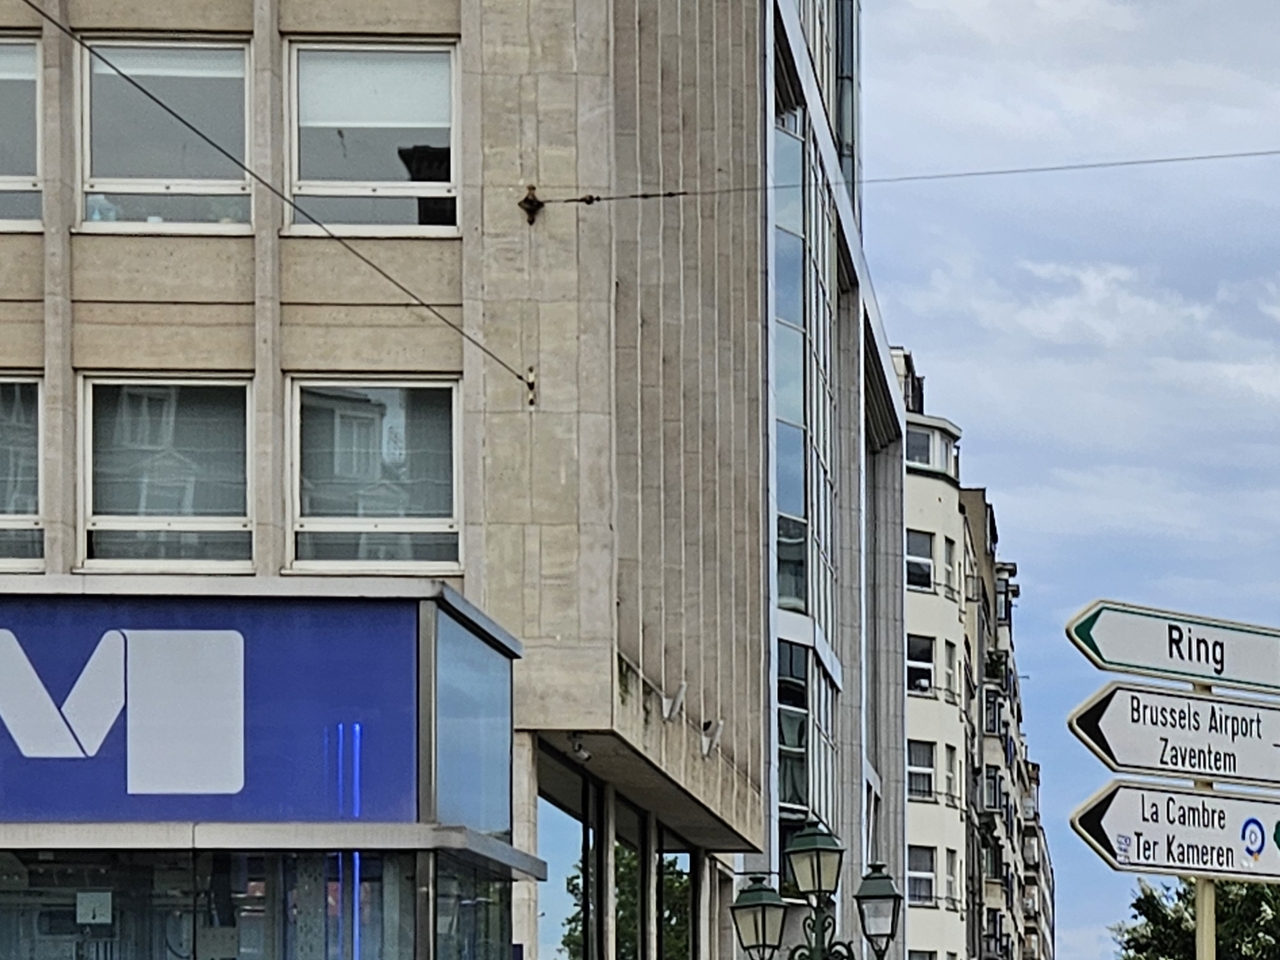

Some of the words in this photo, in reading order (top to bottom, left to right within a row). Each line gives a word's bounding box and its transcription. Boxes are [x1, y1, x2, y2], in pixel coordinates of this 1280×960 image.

[1167, 624, 1226, 675] Ring
[1130, 695, 1200, 731] Brussels
[1208, 705, 1263, 742] Airport
[1159, 737, 1237, 773] Zaventem
[1140, 794, 1159, 824] La
[1165, 796, 1226, 830] Cambre
[1134, 831, 1159, 862] Ter
[1166, 834, 1235, 868] Kameren
